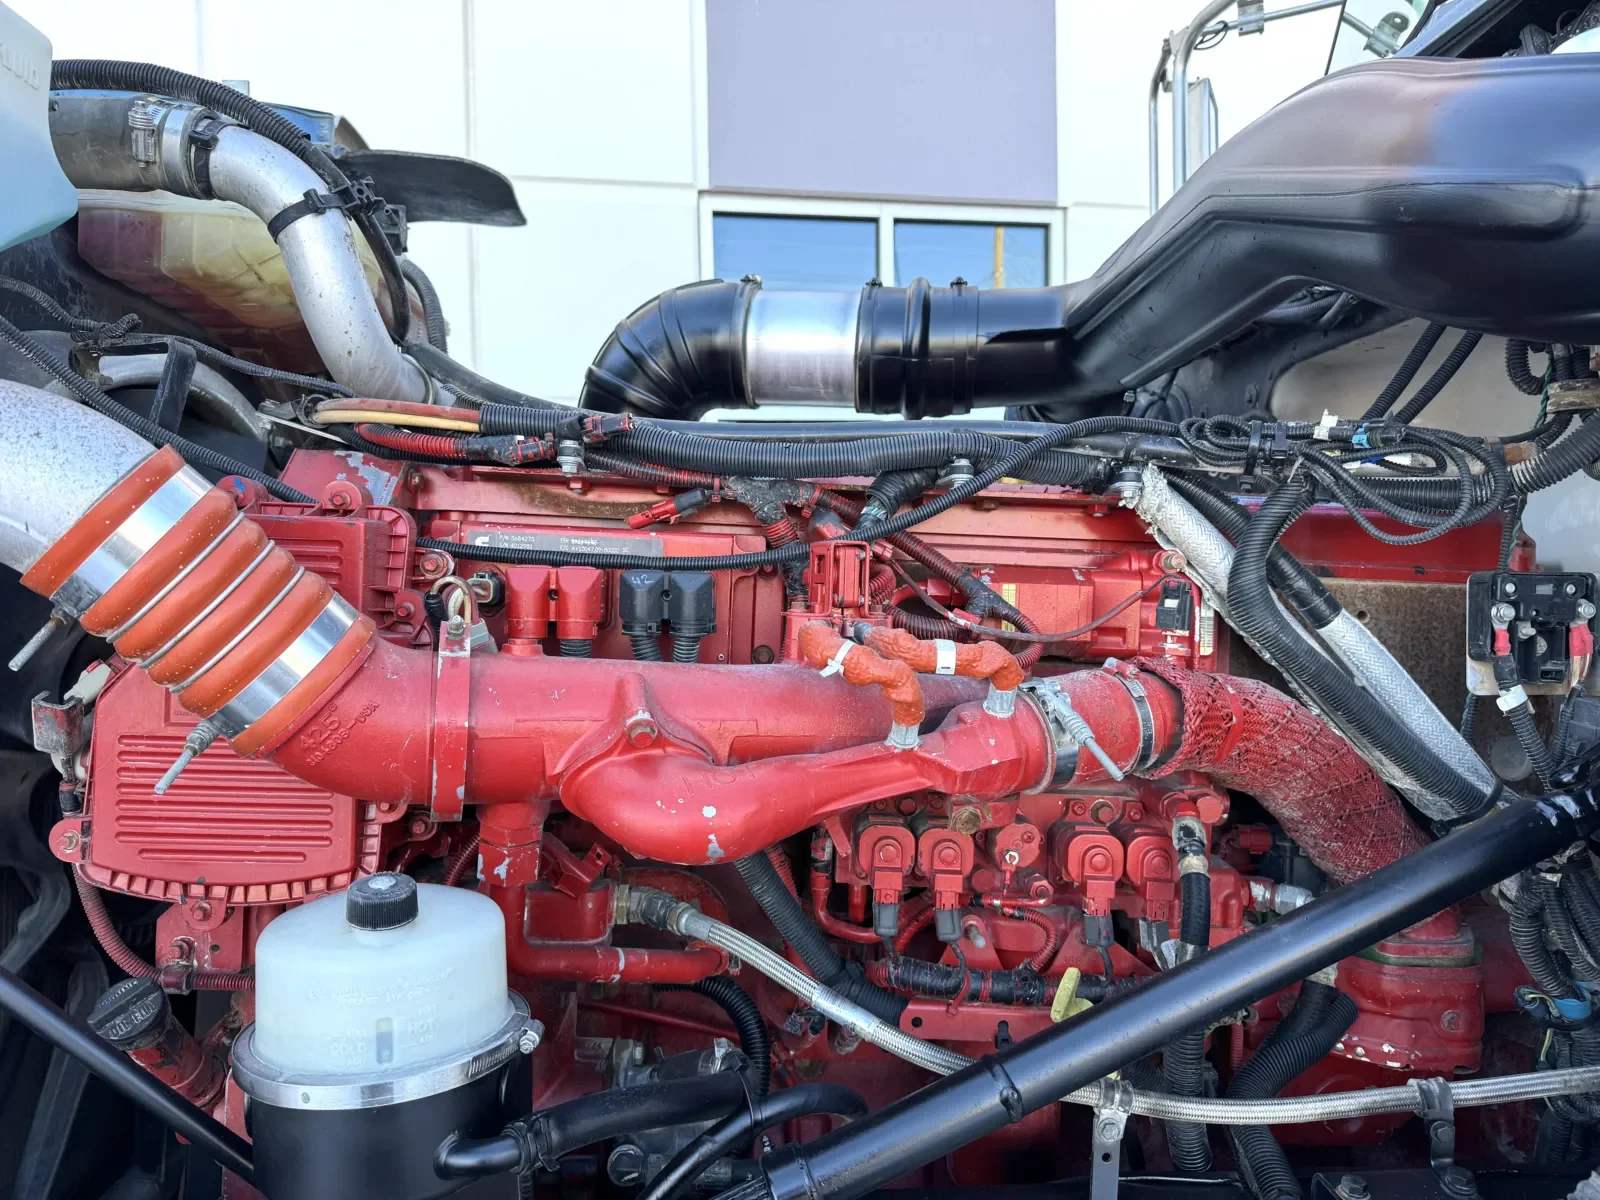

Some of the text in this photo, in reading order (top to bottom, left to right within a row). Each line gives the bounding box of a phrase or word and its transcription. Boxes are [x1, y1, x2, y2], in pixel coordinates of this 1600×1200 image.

[0, 43, 40, 90] LUID
[407, 1018, 433, 1036] HOT
[328, 1041, 368, 1057] COLD
